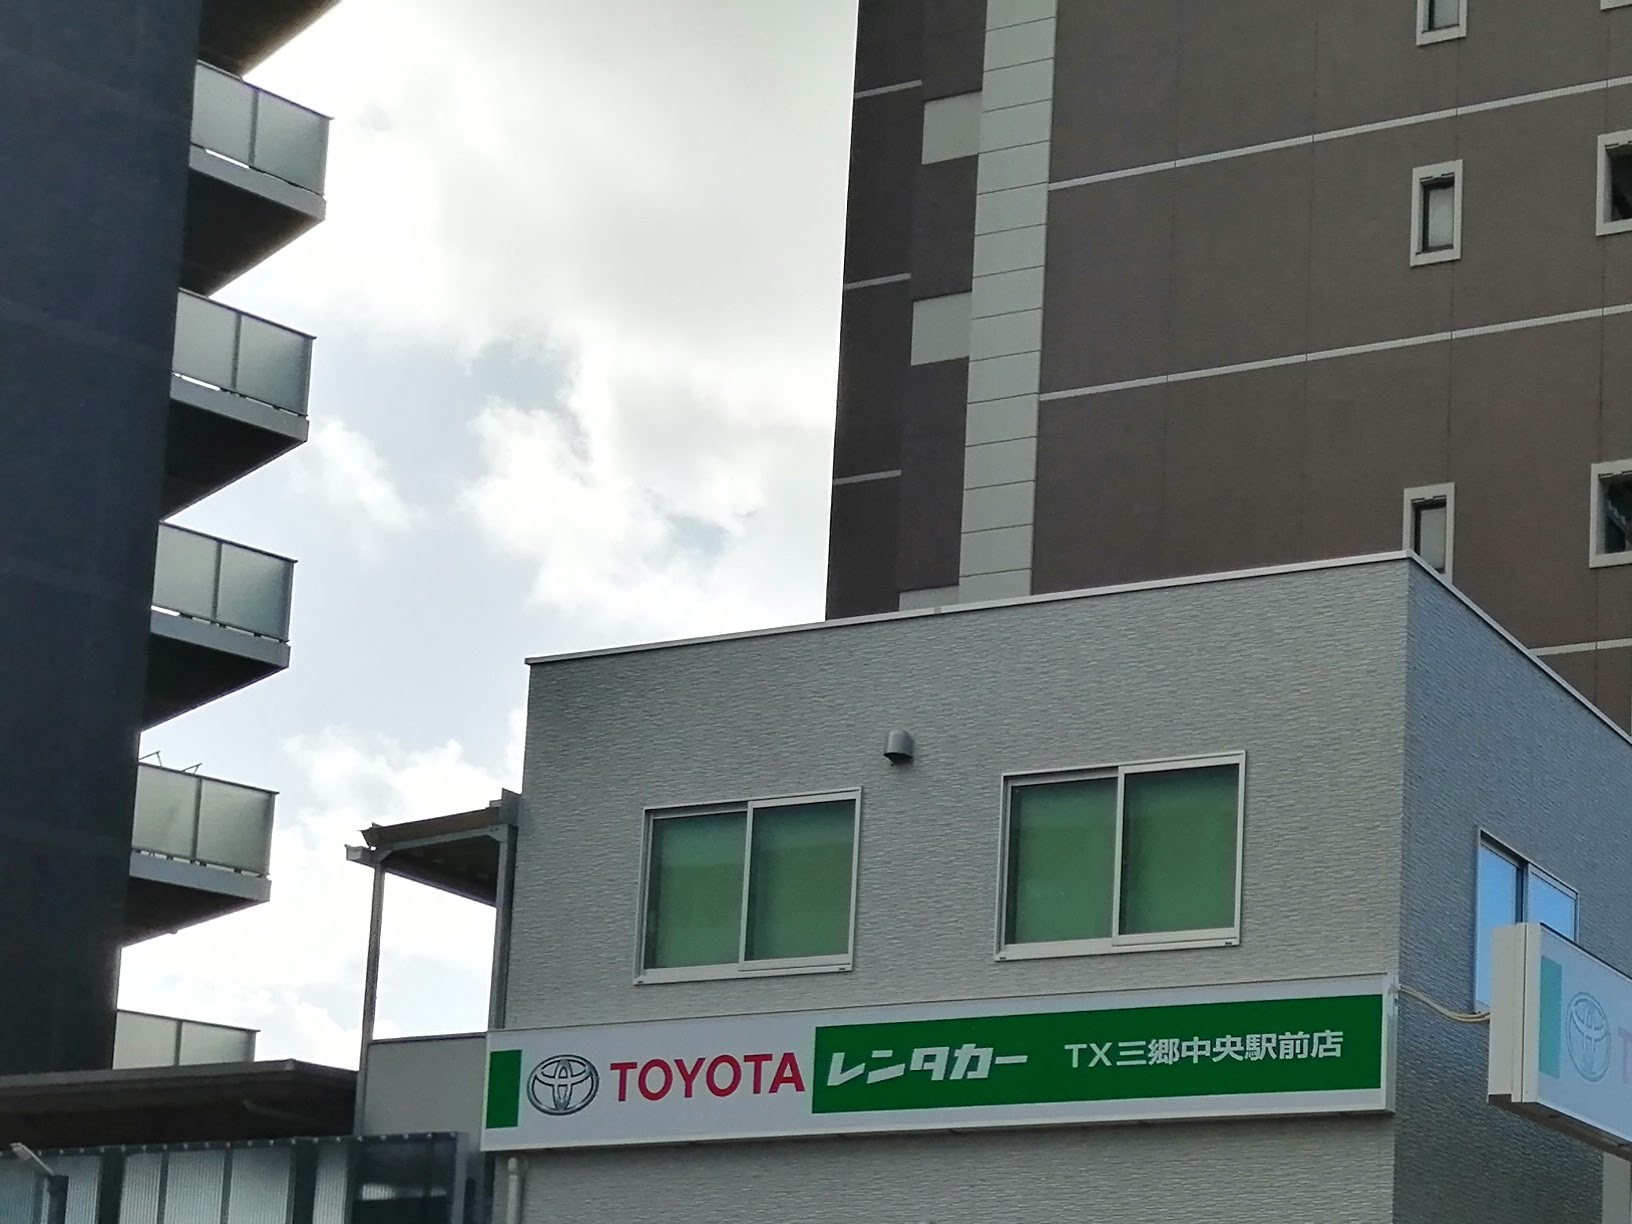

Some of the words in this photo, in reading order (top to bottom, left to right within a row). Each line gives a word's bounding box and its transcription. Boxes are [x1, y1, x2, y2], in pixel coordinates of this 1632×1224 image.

[610, 1052, 806, 1102] TOYOTA
[826, 1042, 1029, 1086] レンタカー
[1064, 1029, 1344, 1069] TX三郷中央駅前店
